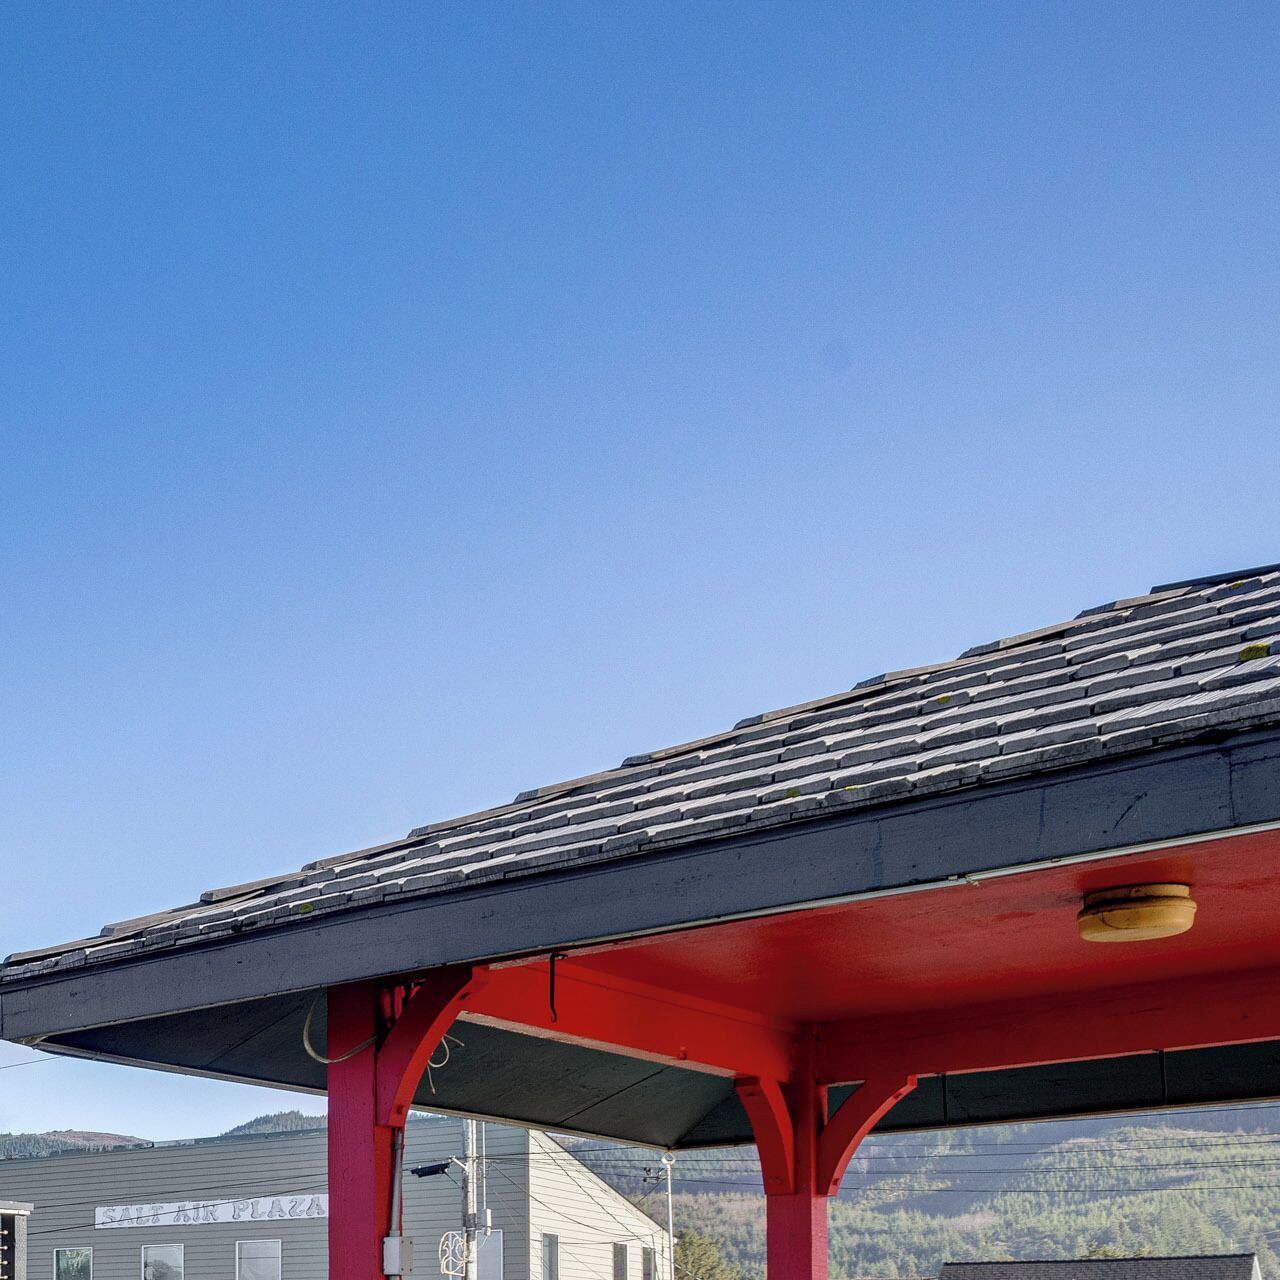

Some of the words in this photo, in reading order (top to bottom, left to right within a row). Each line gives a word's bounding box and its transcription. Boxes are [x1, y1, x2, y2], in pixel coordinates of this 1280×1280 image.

[101, 1206, 164, 1226] SALT
[173, 1203, 219, 1223] AIR
[232, 1196, 326, 1220] PLAZA
